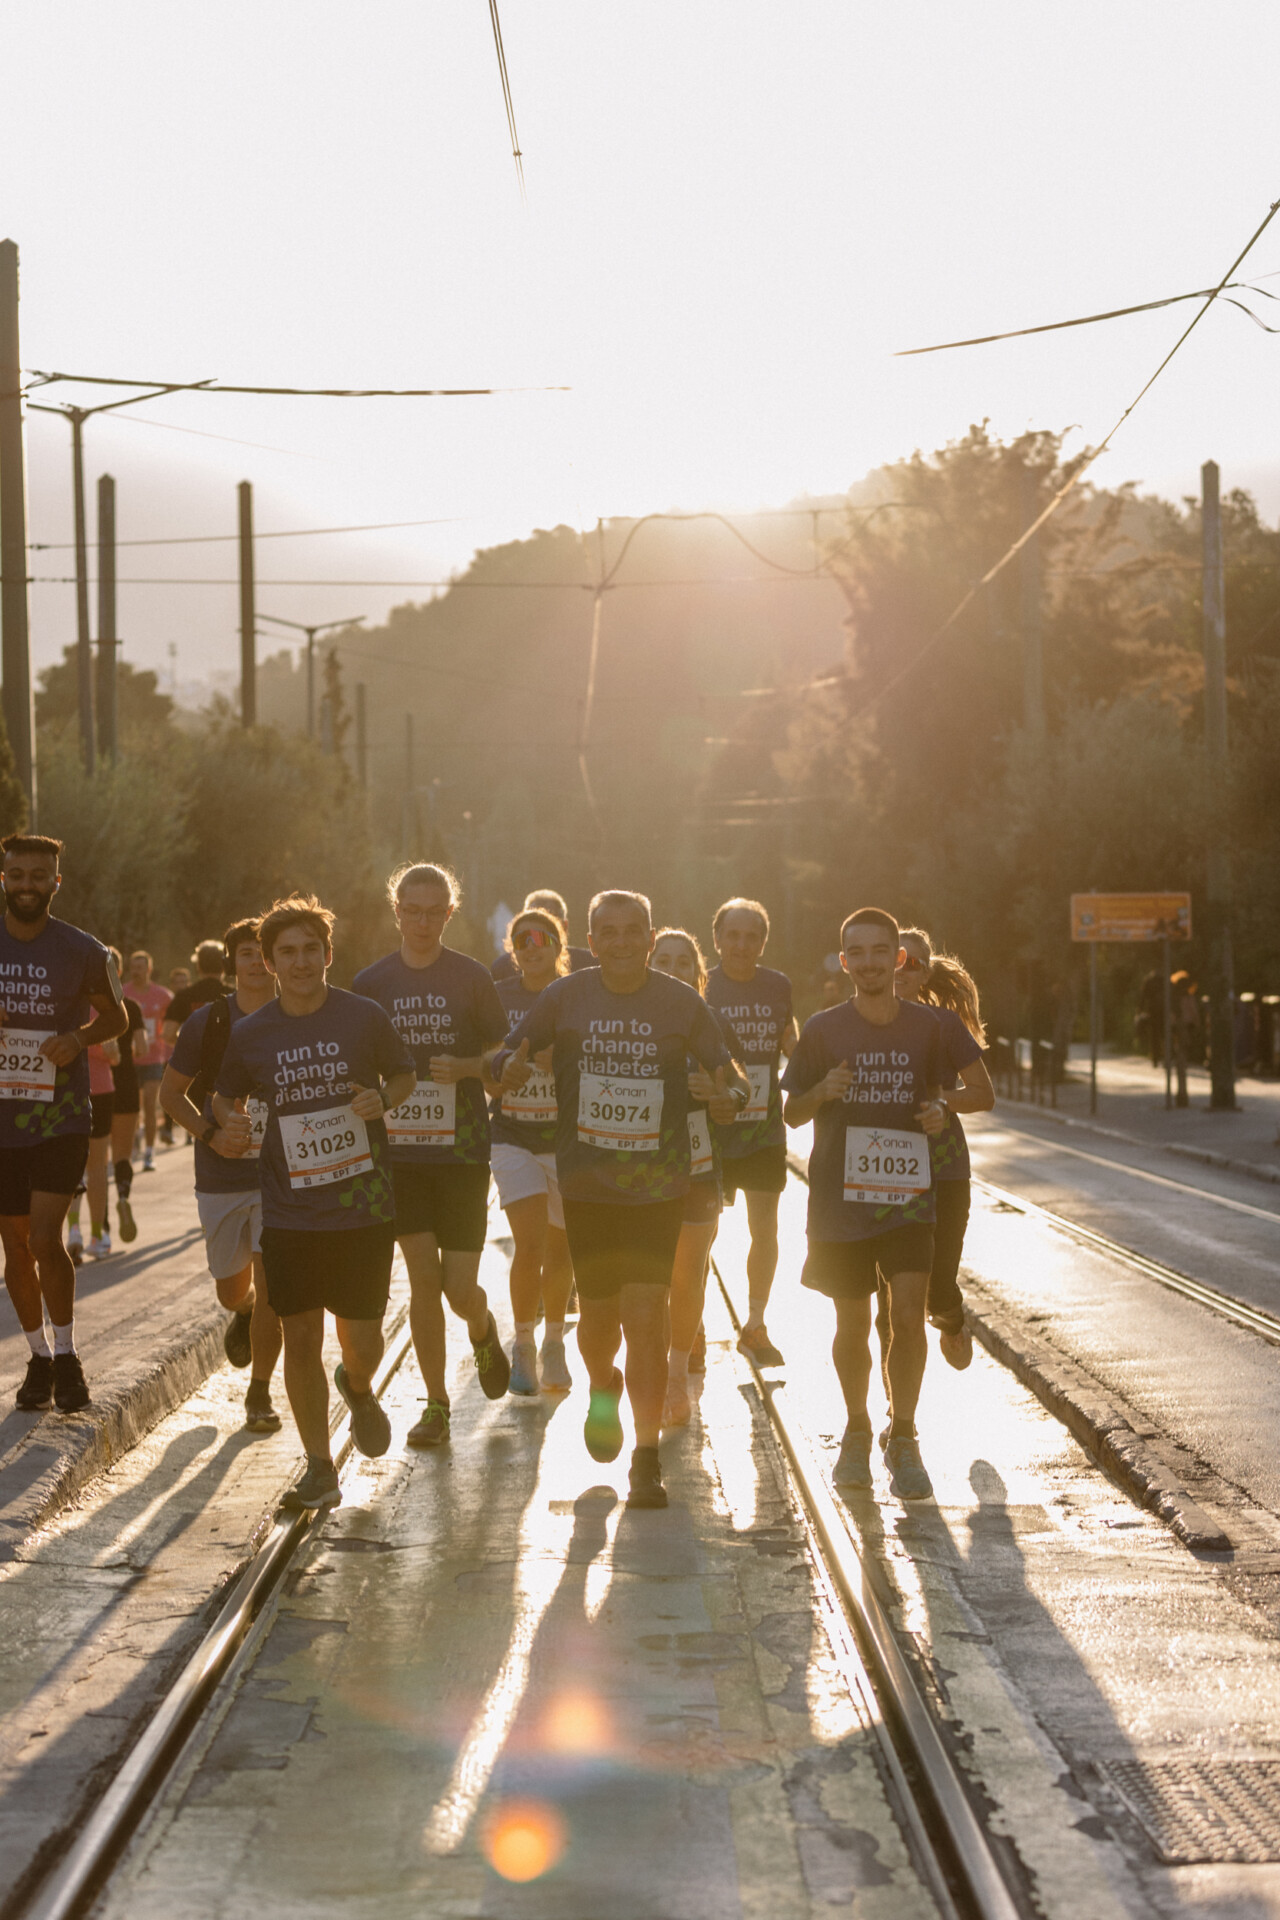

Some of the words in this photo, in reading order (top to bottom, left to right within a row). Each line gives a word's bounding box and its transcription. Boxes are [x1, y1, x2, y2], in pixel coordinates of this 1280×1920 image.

[0, 962, 22, 978] un
[27, 962, 47, 979] to
[393, 994, 422, 1011] run
[426, 992, 447, 1009] to
[720, 1005, 750, 1018] run
[754, 1003, 772, 1017] to
[402, 1028, 456, 1046] abetes
[589, 1018, 625, 1035] run
[629, 1018, 653, 1036] to
[276, 1045, 312, 1065] run
[315, 1040, 340, 1057] to
[581, 1034, 658, 1060] change
[0, 1054, 44, 1073] 2922
[577, 1056, 661, 1077] diabetes
[855, 1051, 886, 1066] run
[889, 1049, 910, 1066] to
[274, 1061, 349, 1086] change
[850, 1066, 914, 1089] change
[275, 1080, 354, 1107] diabetes
[842, 1085, 915, 1104] diabetes
[389, 1104, 444, 1120] 32919
[590, 1101, 651, 1122] 30974
[296, 1130, 356, 1159] 31029
[858, 1154, 919, 1176] 31032
